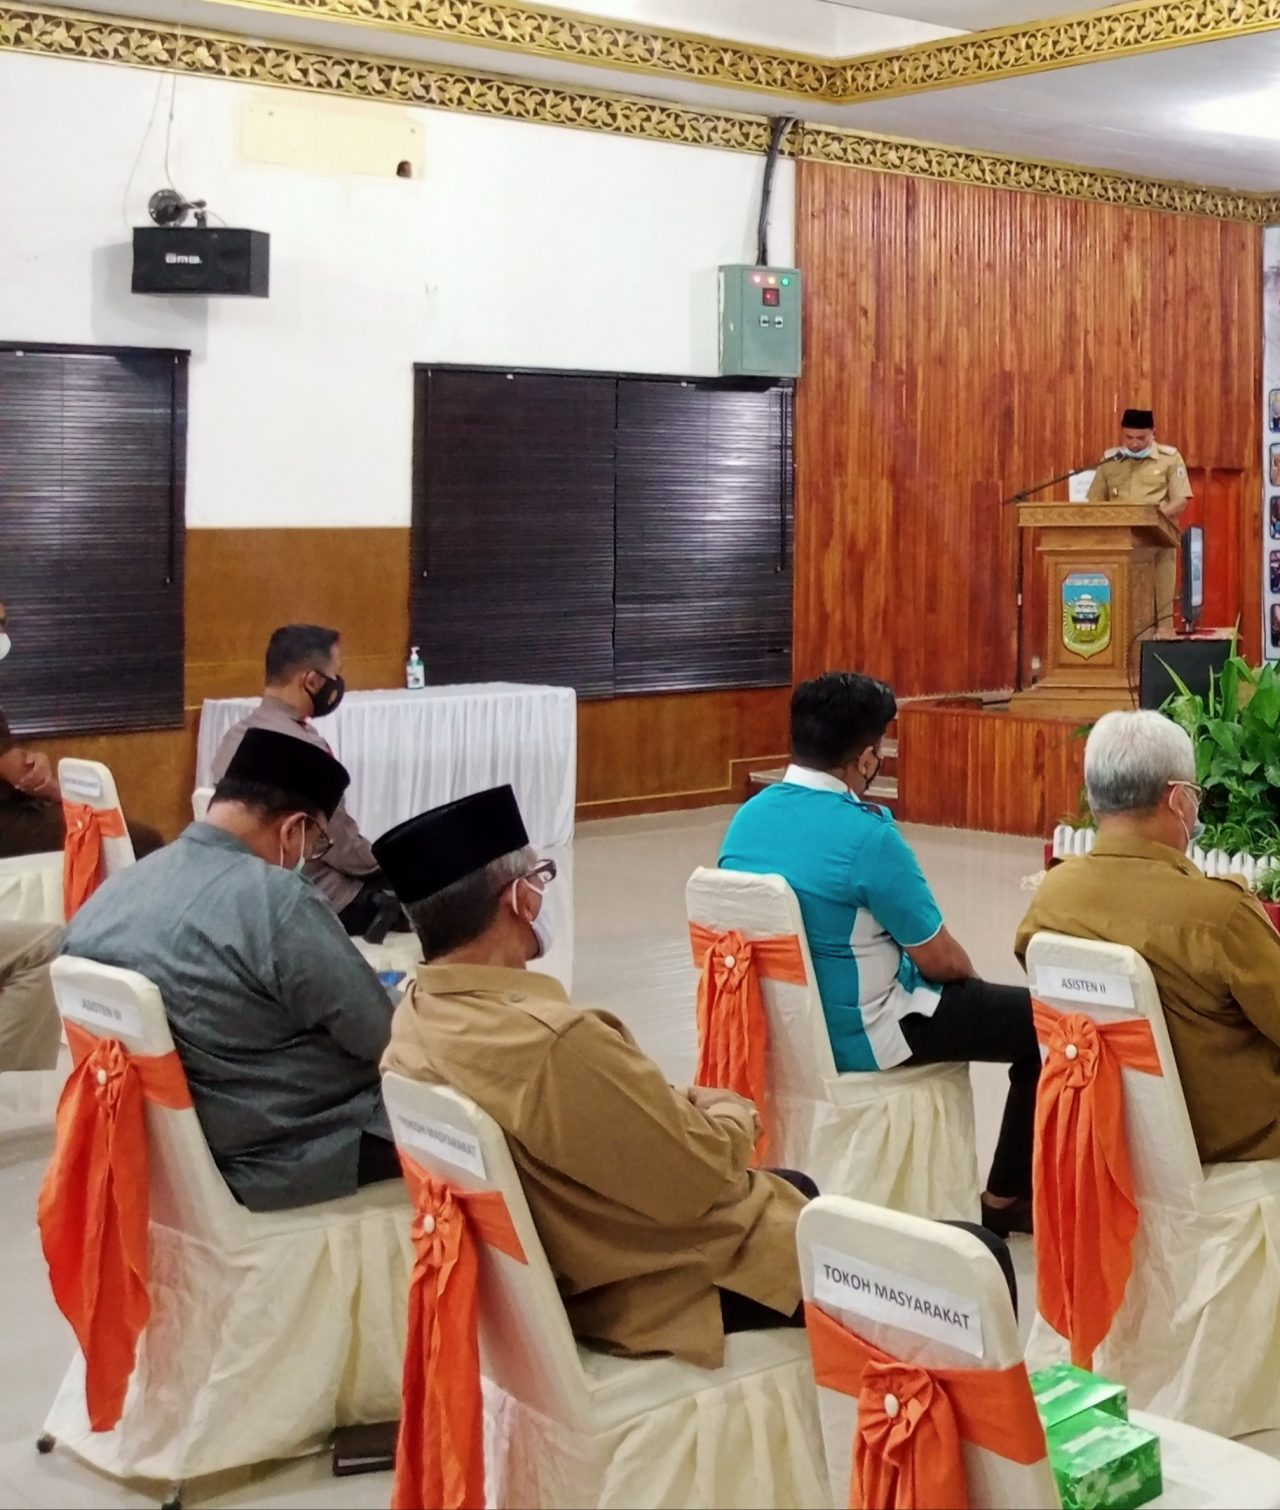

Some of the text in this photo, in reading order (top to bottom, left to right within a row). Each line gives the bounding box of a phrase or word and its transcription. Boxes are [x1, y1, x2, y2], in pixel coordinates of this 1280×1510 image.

[1061, 978, 1106, 994] ASISTEN II
[823, 1264, 970, 1330] TOKOH MASYARAKAT
